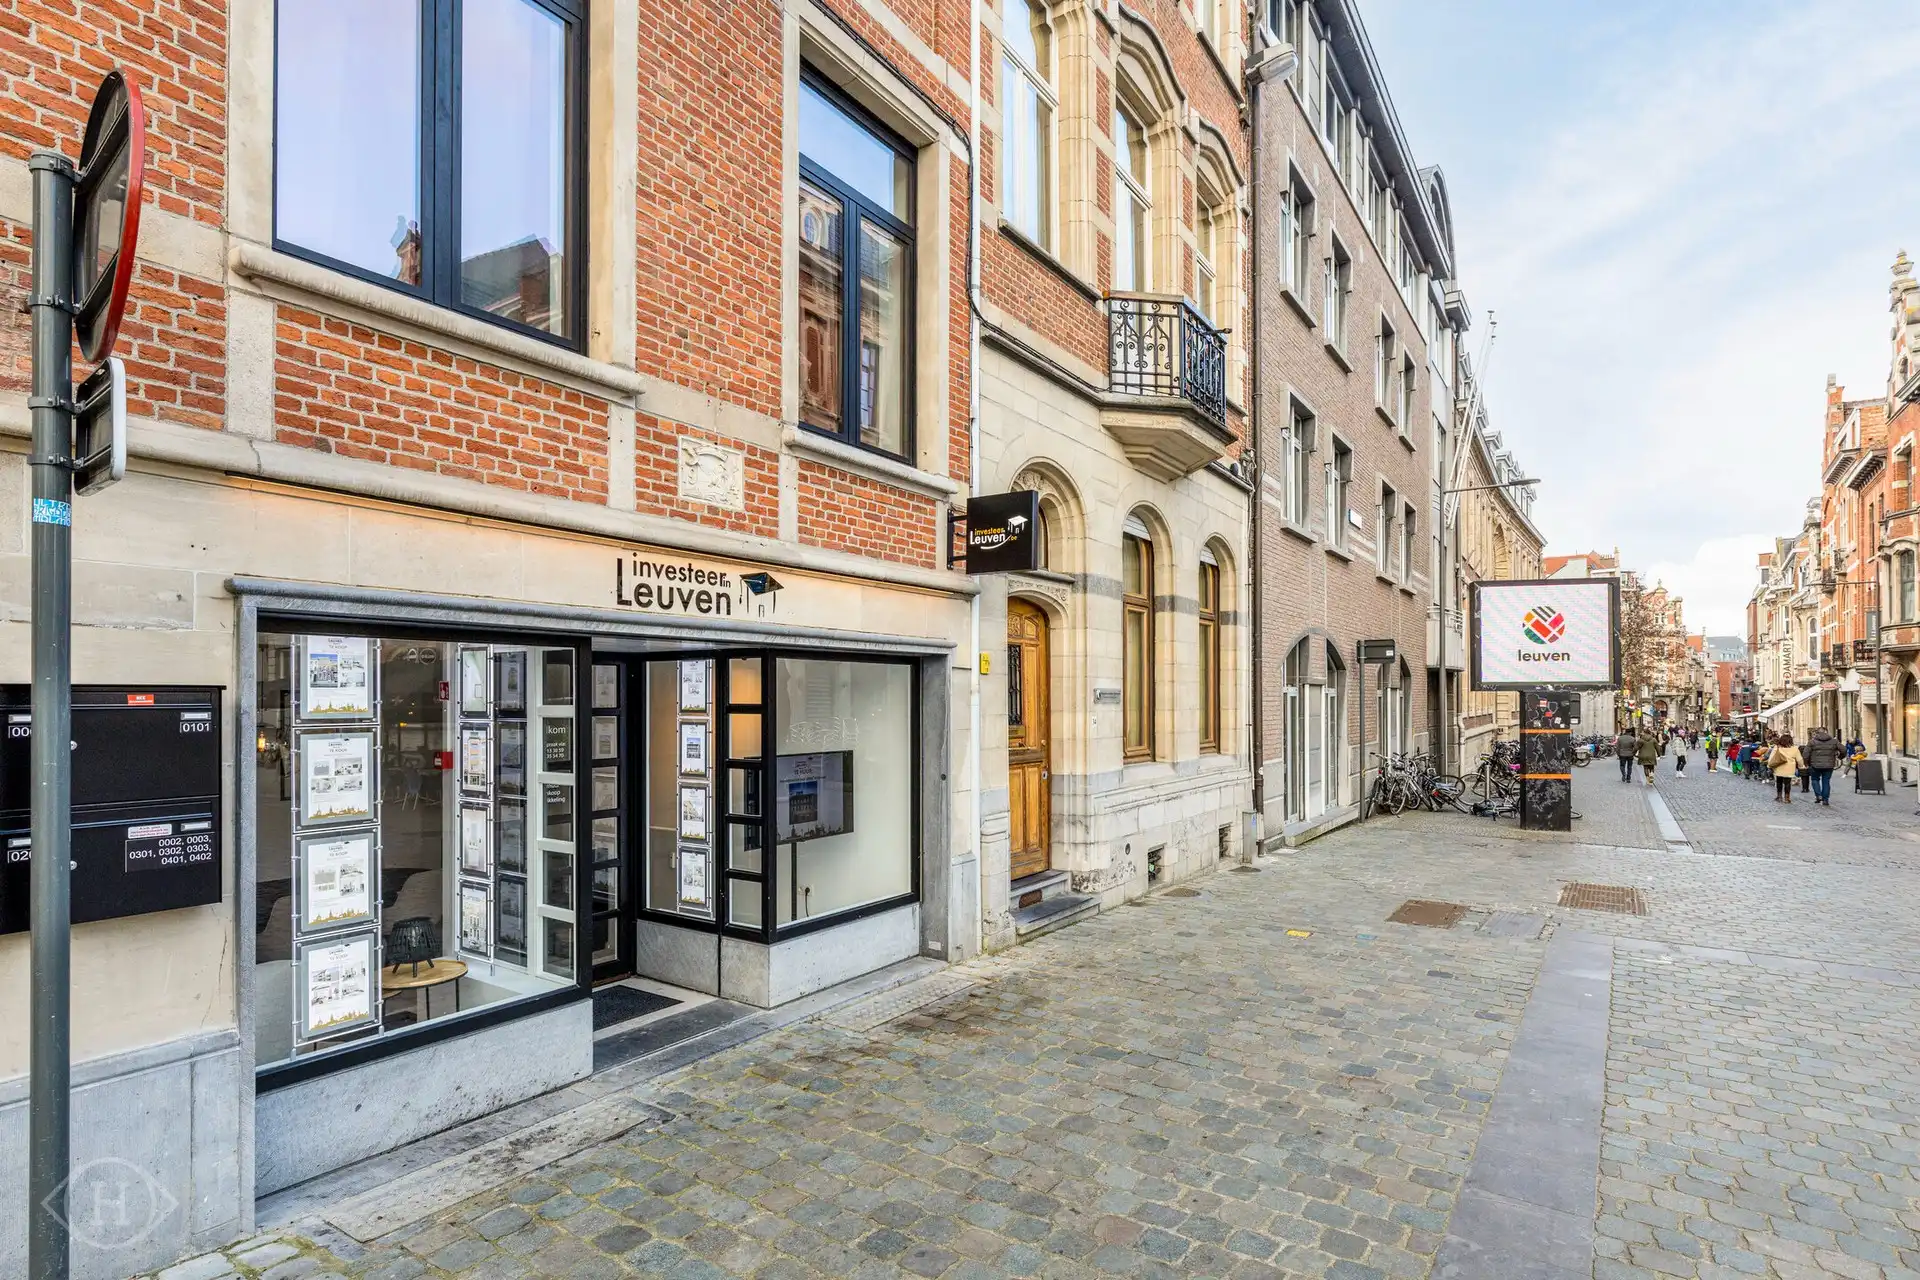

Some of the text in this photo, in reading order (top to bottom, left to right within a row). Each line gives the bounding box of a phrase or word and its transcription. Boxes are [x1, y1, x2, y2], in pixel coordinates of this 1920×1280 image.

[970, 530, 1006, 545] Leuven
[632, 552, 731, 588] investeer in
[616, 558, 732, 616] Leuven
[1518, 649, 1571, 661] leuven
[11, 726, 32, 737] 00
[182, 722, 210, 733] 0101
[159, 834, 212, 847] 0002, 0003,
[129, 844, 212, 859] 0301, 0302, 0303,
[161, 852, 212, 865] 0401, 0402
